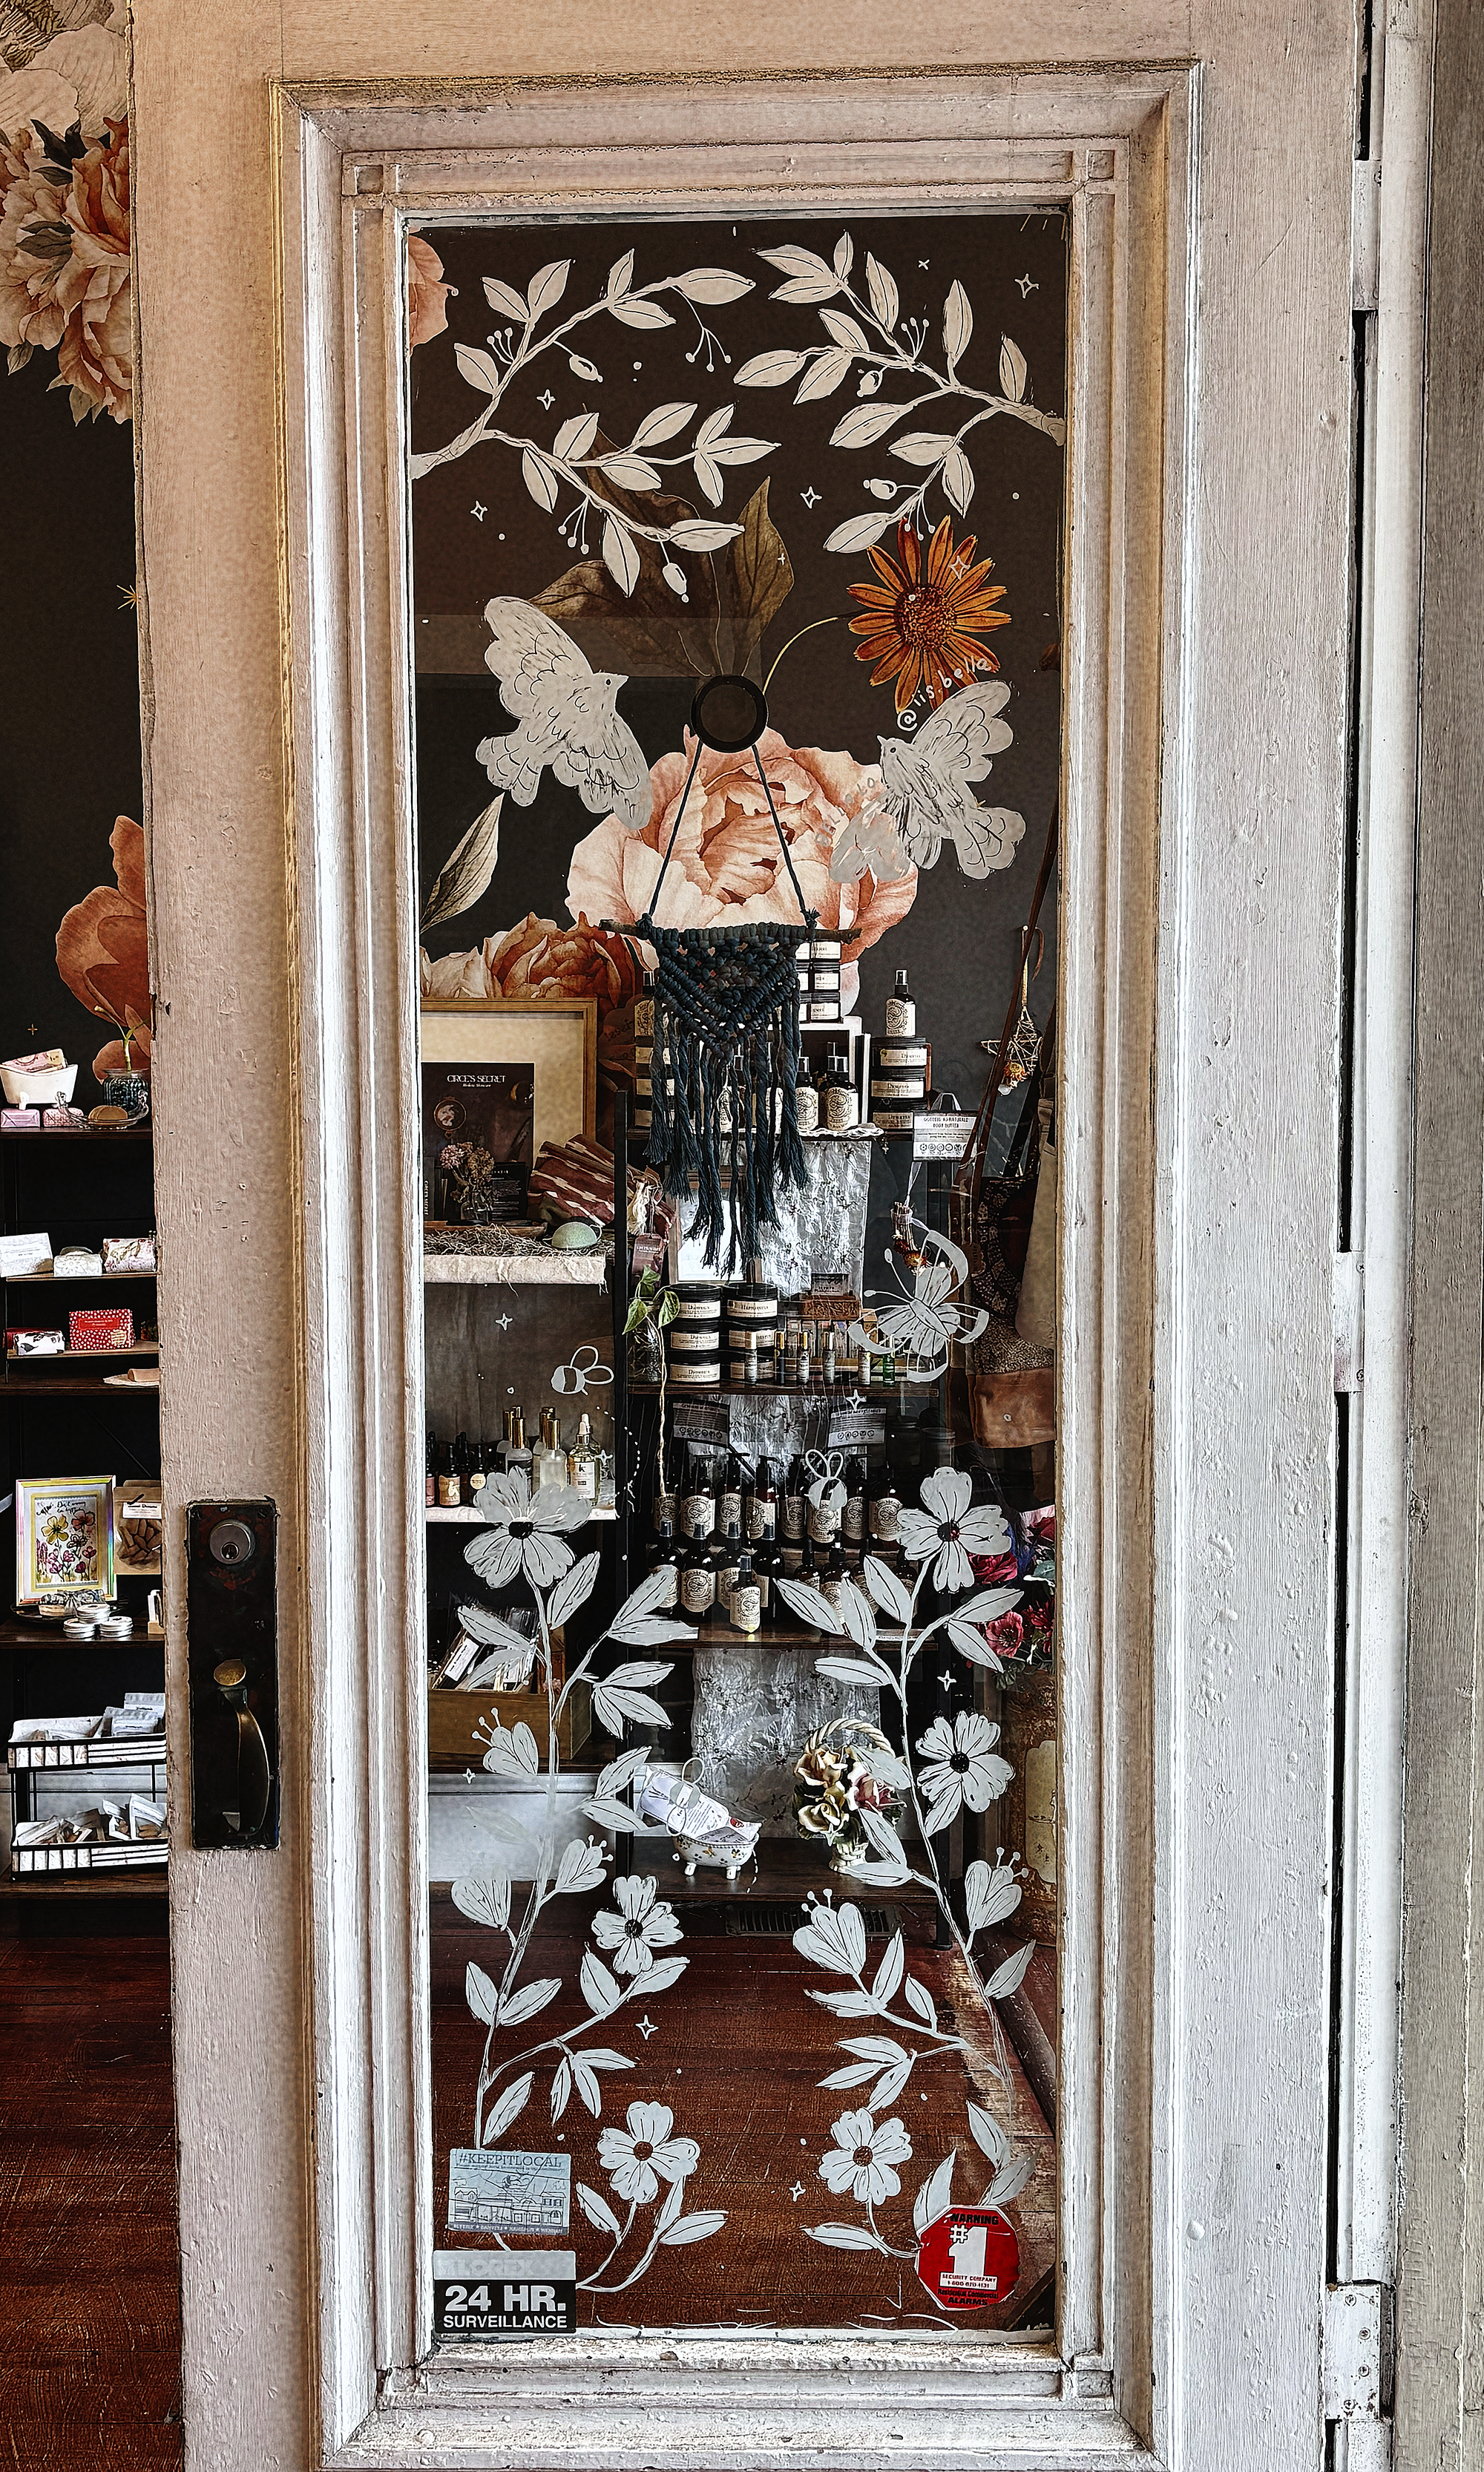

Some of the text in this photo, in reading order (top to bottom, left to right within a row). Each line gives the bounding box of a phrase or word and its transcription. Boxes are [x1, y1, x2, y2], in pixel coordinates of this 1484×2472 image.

[459, 2153, 562, 2168] #KEEPITLOCAL
[951, 2213, 999, 2225] WARNING
[445, 2285, 566, 2312] 24 HR.
[948, 2297, 988, 2306] ALARMS
[443, 2315, 568, 2328] SURVEILLANCE
